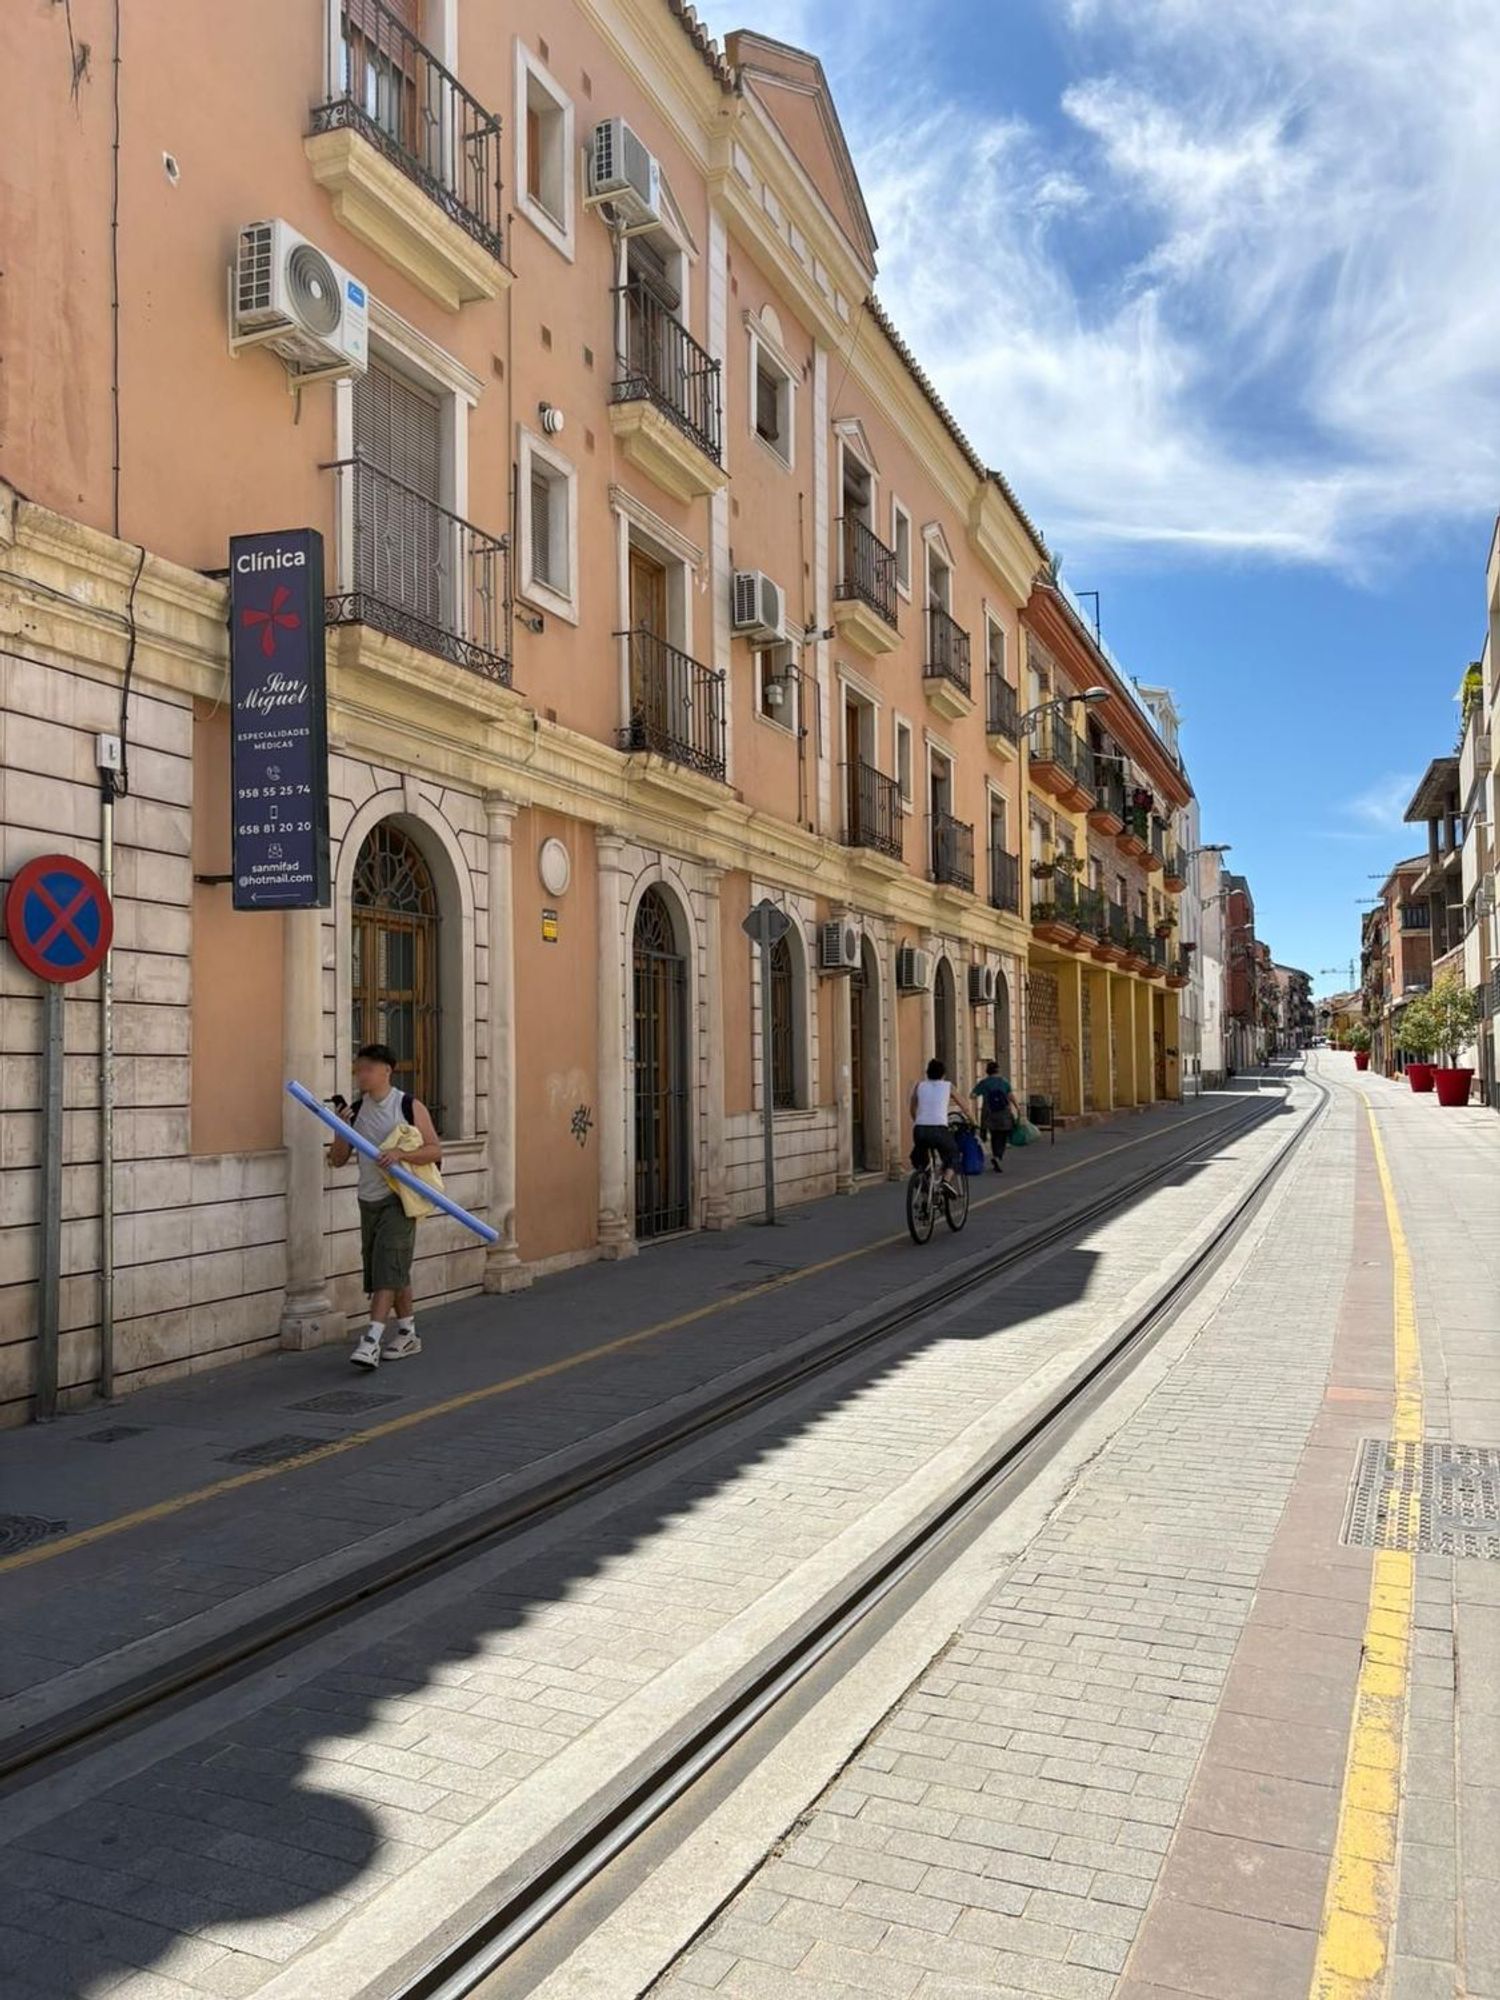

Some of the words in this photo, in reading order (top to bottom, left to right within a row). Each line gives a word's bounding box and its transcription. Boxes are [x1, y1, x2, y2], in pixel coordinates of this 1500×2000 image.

[237, 549, 306, 573] Clínica
[262, 672, 302, 694] San
[237, 684, 310, 716] Miguel
[237, 728, 310, 741] ESPECIALIDADES
[238, 788, 260, 799] 958
[262, 787, 277, 797] 55
[279, 786, 294, 796] 25
[297, 785, 311, 795] 74
[239, 826, 260, 836] 658
[263, 824, 275, 834] 81
[279, 823, 294, 833] 20
[297, 822, 312, 832] 20
[251, 861, 300, 873] sanmifad
[238, 873, 314, 888] @hotmail.com
